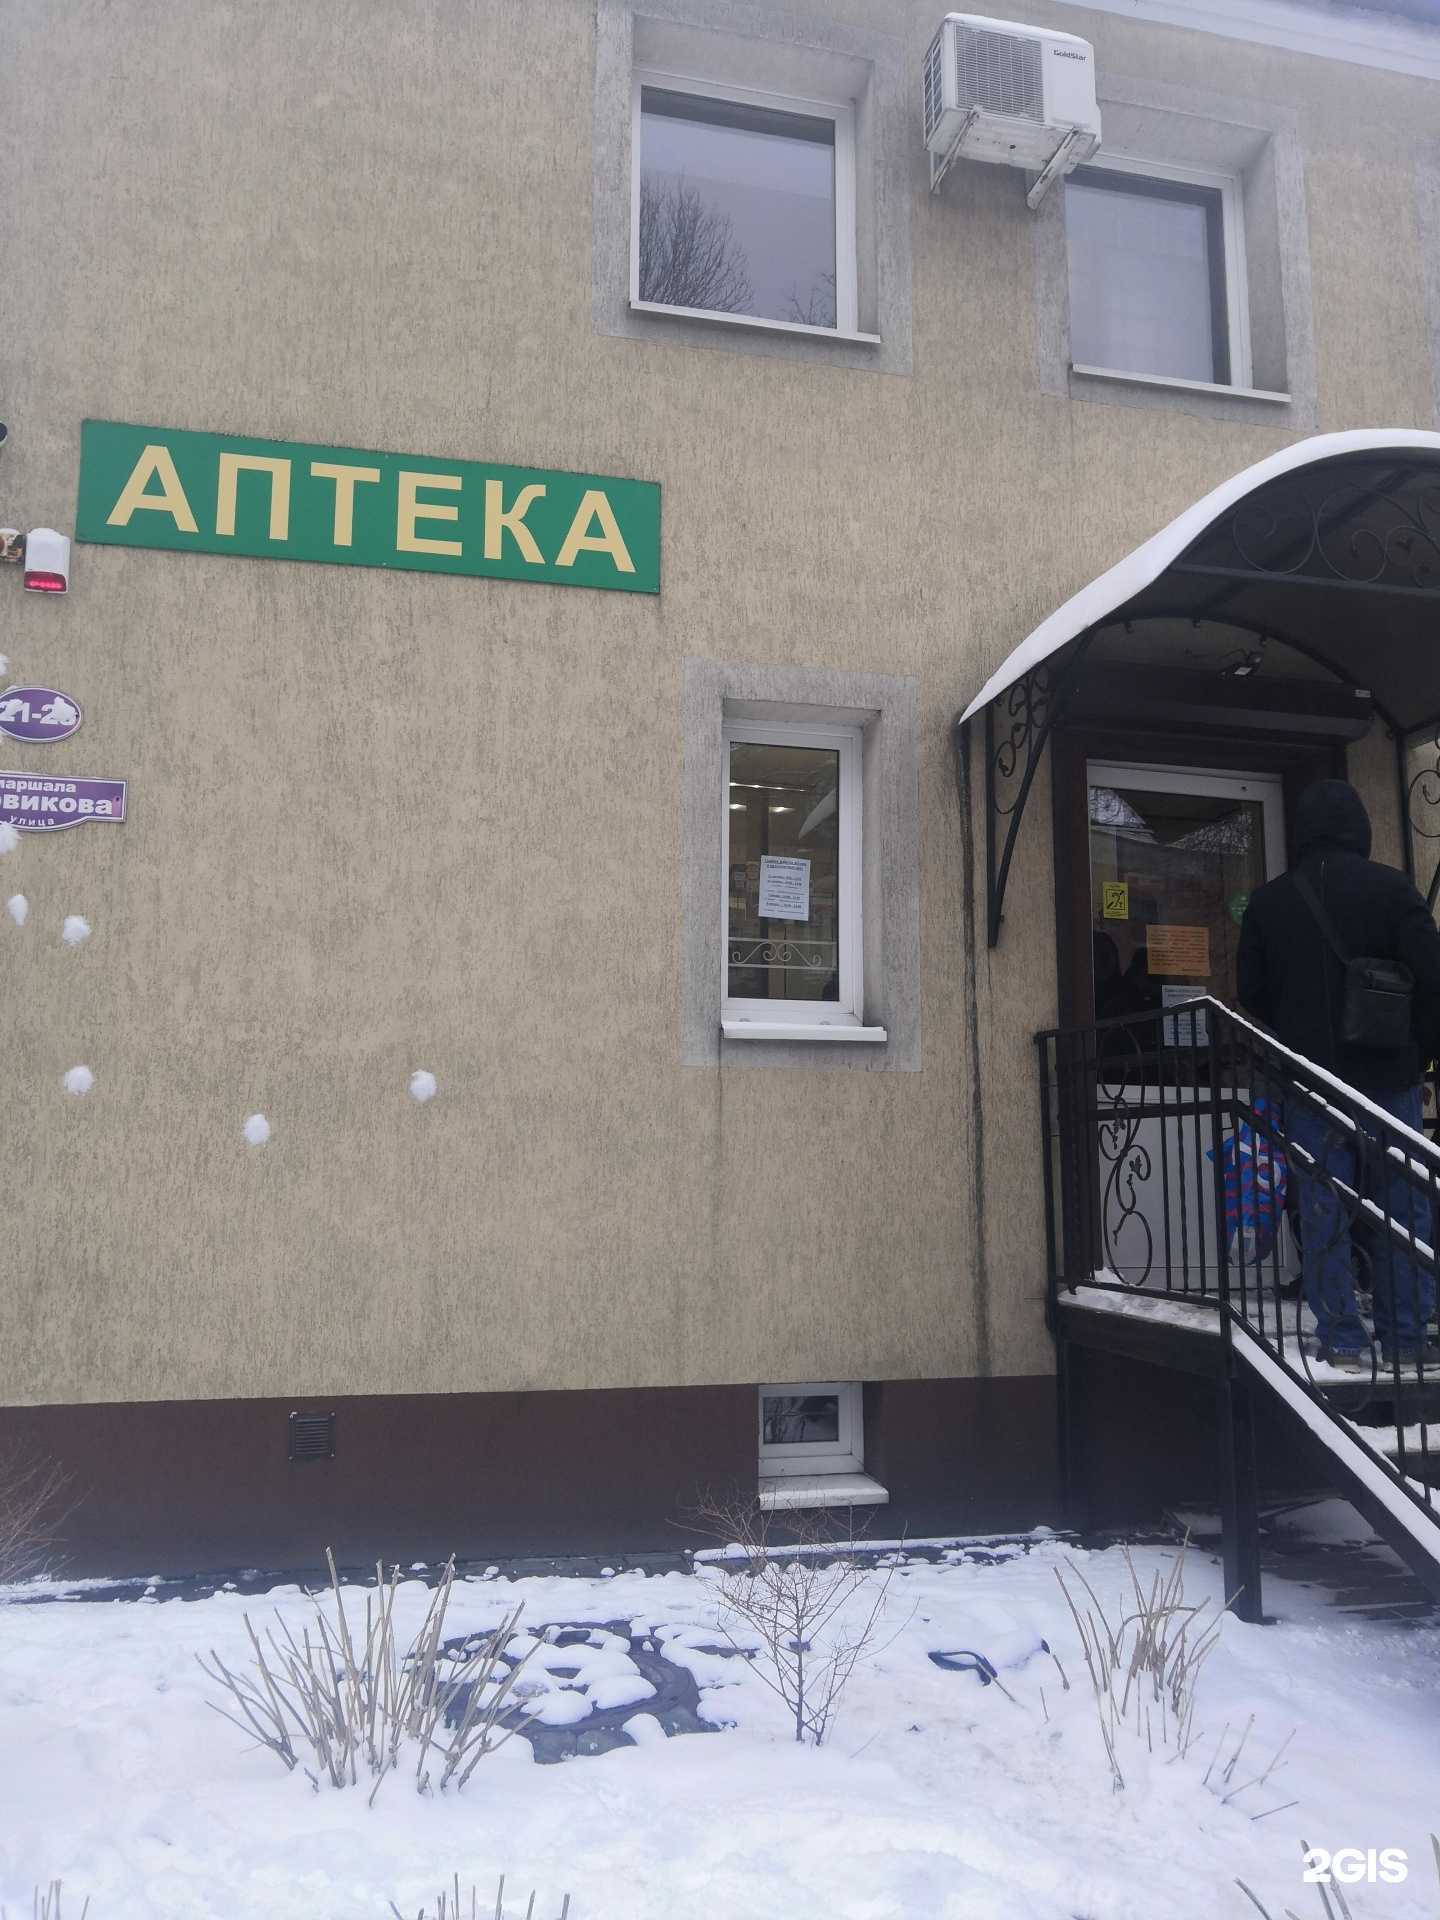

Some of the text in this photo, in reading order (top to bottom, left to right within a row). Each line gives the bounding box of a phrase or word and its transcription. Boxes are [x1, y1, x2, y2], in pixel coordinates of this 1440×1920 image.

[106, 444, 636, 573] АПТЕКА
[0, 794, 113, 815] викова
[9, 815, 55, 827] улица
